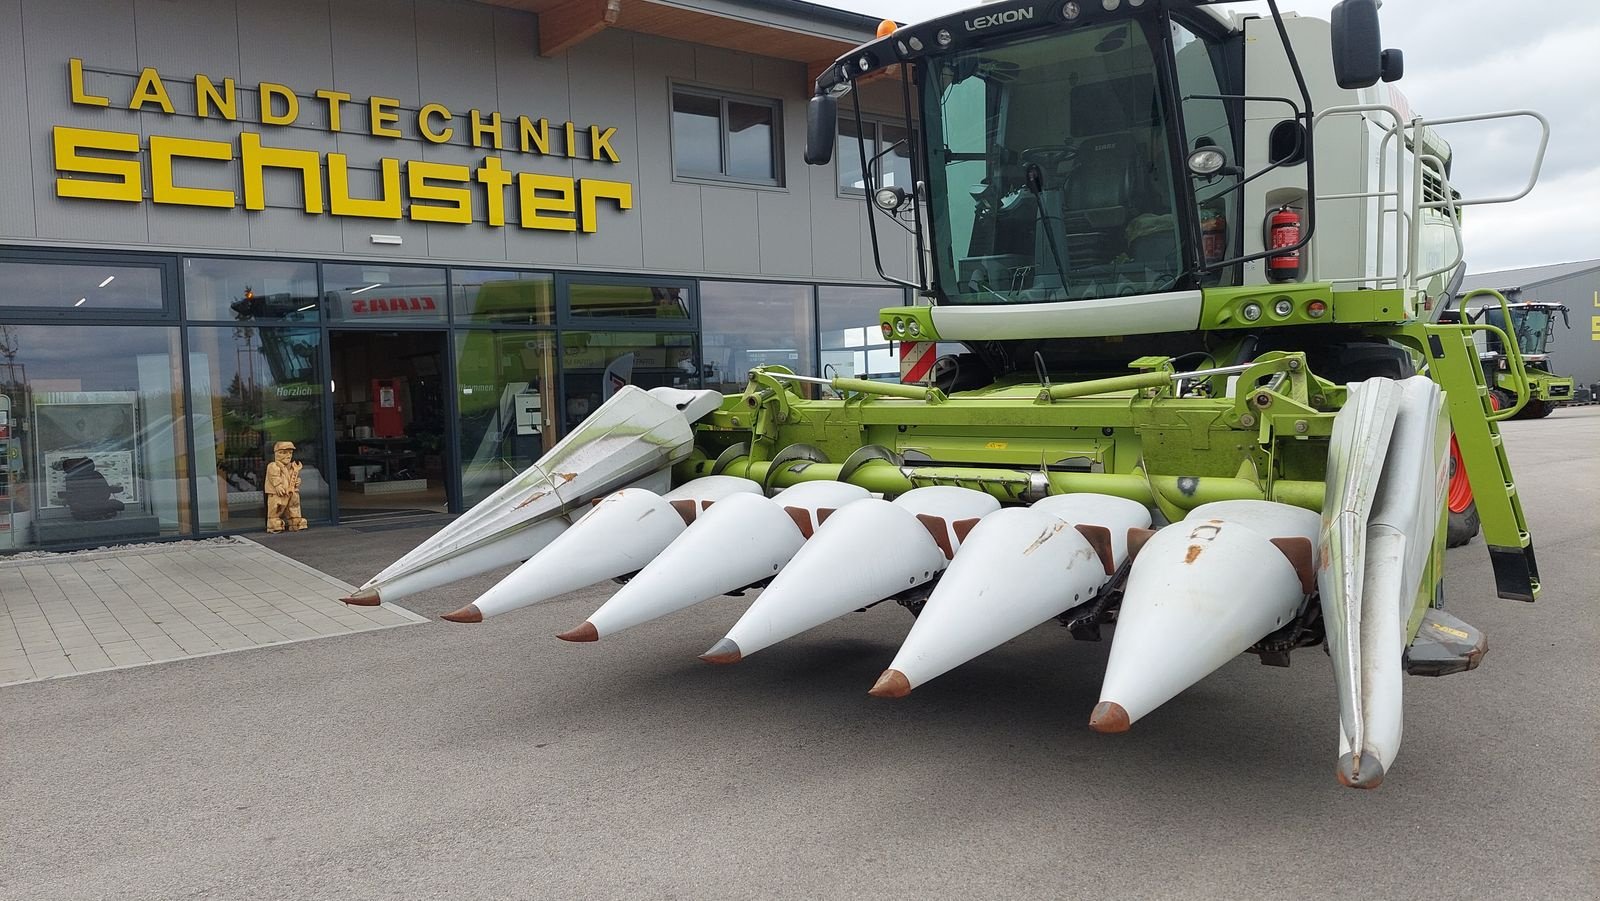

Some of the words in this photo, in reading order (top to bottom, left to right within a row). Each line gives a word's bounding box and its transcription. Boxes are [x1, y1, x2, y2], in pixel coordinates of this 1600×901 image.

[964, 7, 1033, 31] LEXION
[68, 57, 621, 164] LANDTECHNIK
[276, 386, 312, 397] Herzlich
